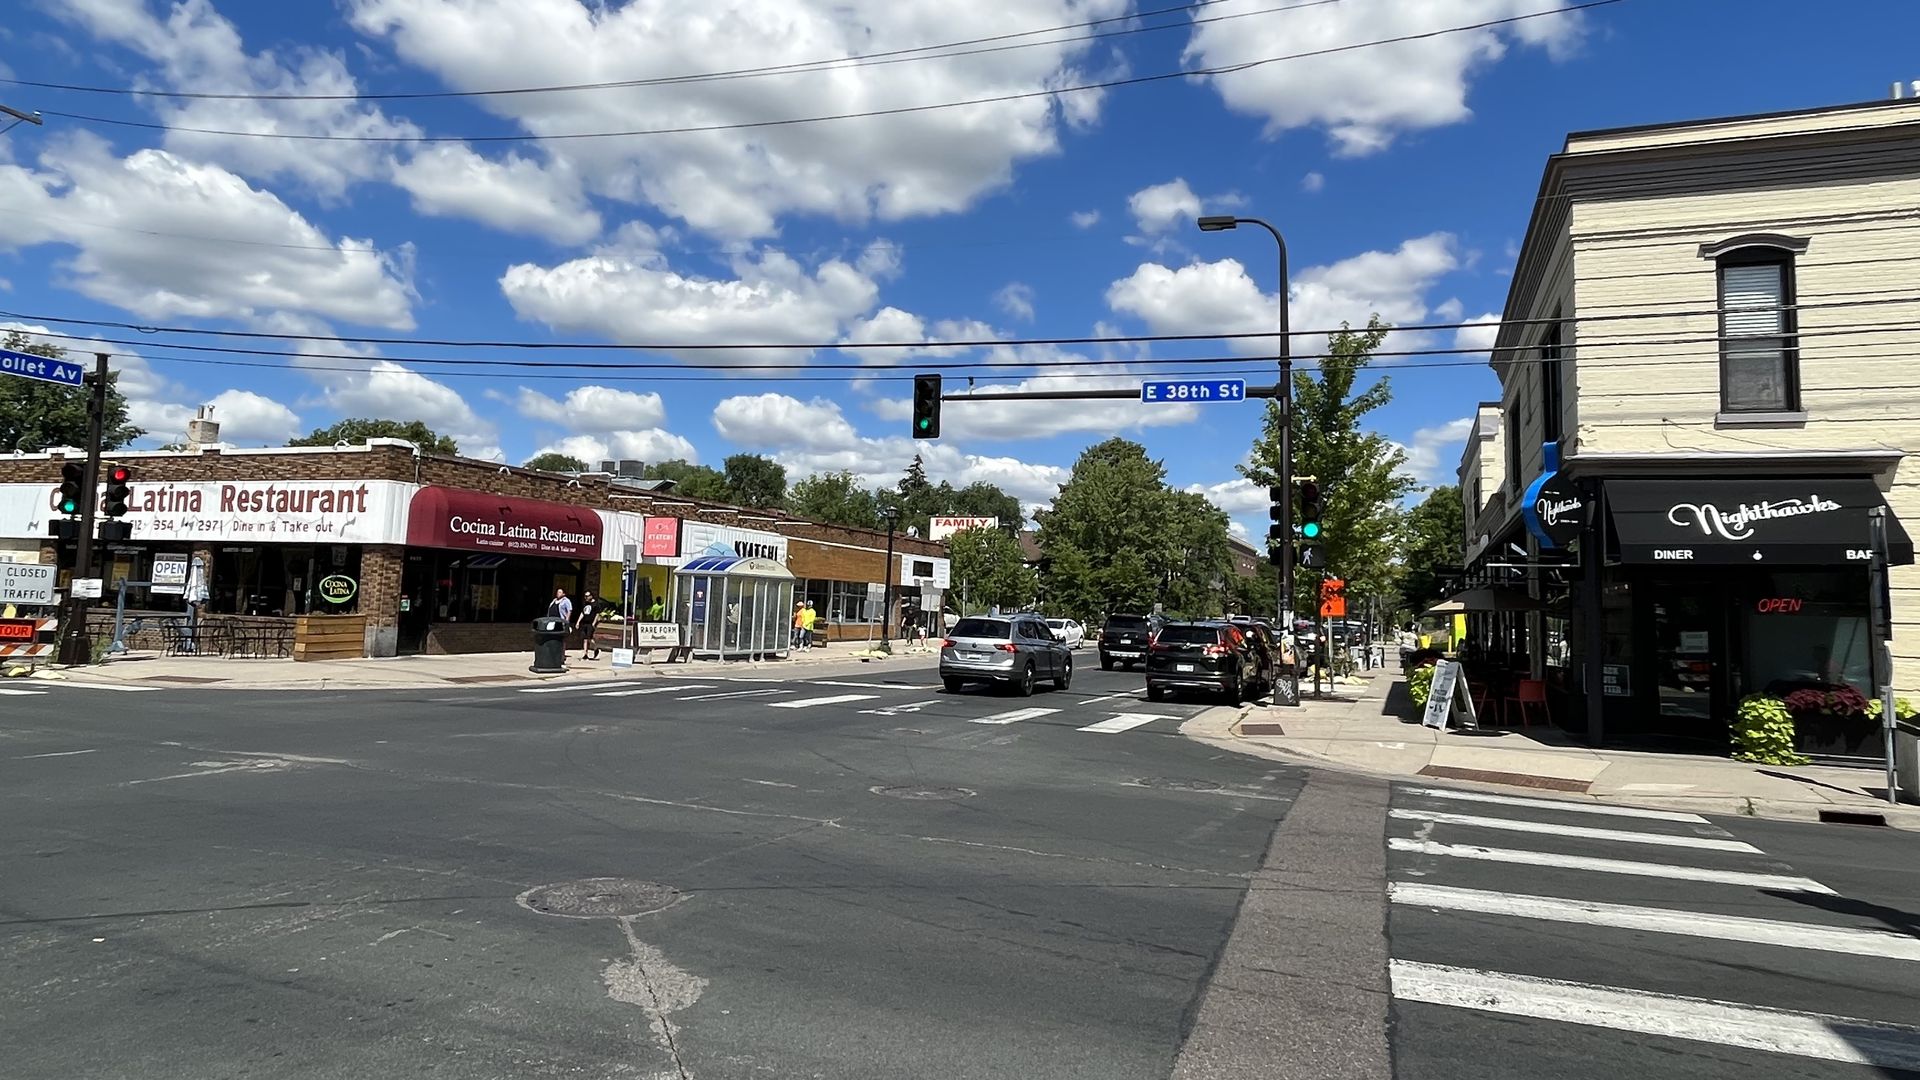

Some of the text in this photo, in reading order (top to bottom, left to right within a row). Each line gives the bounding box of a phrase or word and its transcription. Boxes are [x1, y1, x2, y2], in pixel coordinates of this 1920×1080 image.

[0, 357, 77, 380] ollet Av
[1146, 384, 1240, 399] E 38th St
[127, 484, 202, 513] Latina
[220, 483, 369, 513] Restaurant
[1536, 497, 1582, 526] Nighthawks
[1667, 494, 1842, 541] Nighthawks
[153, 519, 174, 531] 354
[232, 520, 254, 532] Dine
[257, 520, 266, 532] in
[282, 521, 309, 533] Take
[315, 521, 334, 533] out
[935, 518, 988, 528] FAMILY
[450, 516, 596, 546] Cocina Latina Restaurant
[1654, 549, 1694, 560] DINER
[7, 567, 48, 578] CLOSED
[155, 562, 186, 574] OPEN
[4, 579, 15, 587] TO
[4, 589, 46, 600] TRAFFIC
[1758, 598, 1802, 612] OPEN
[640, 626, 677, 634] RARE FORM
